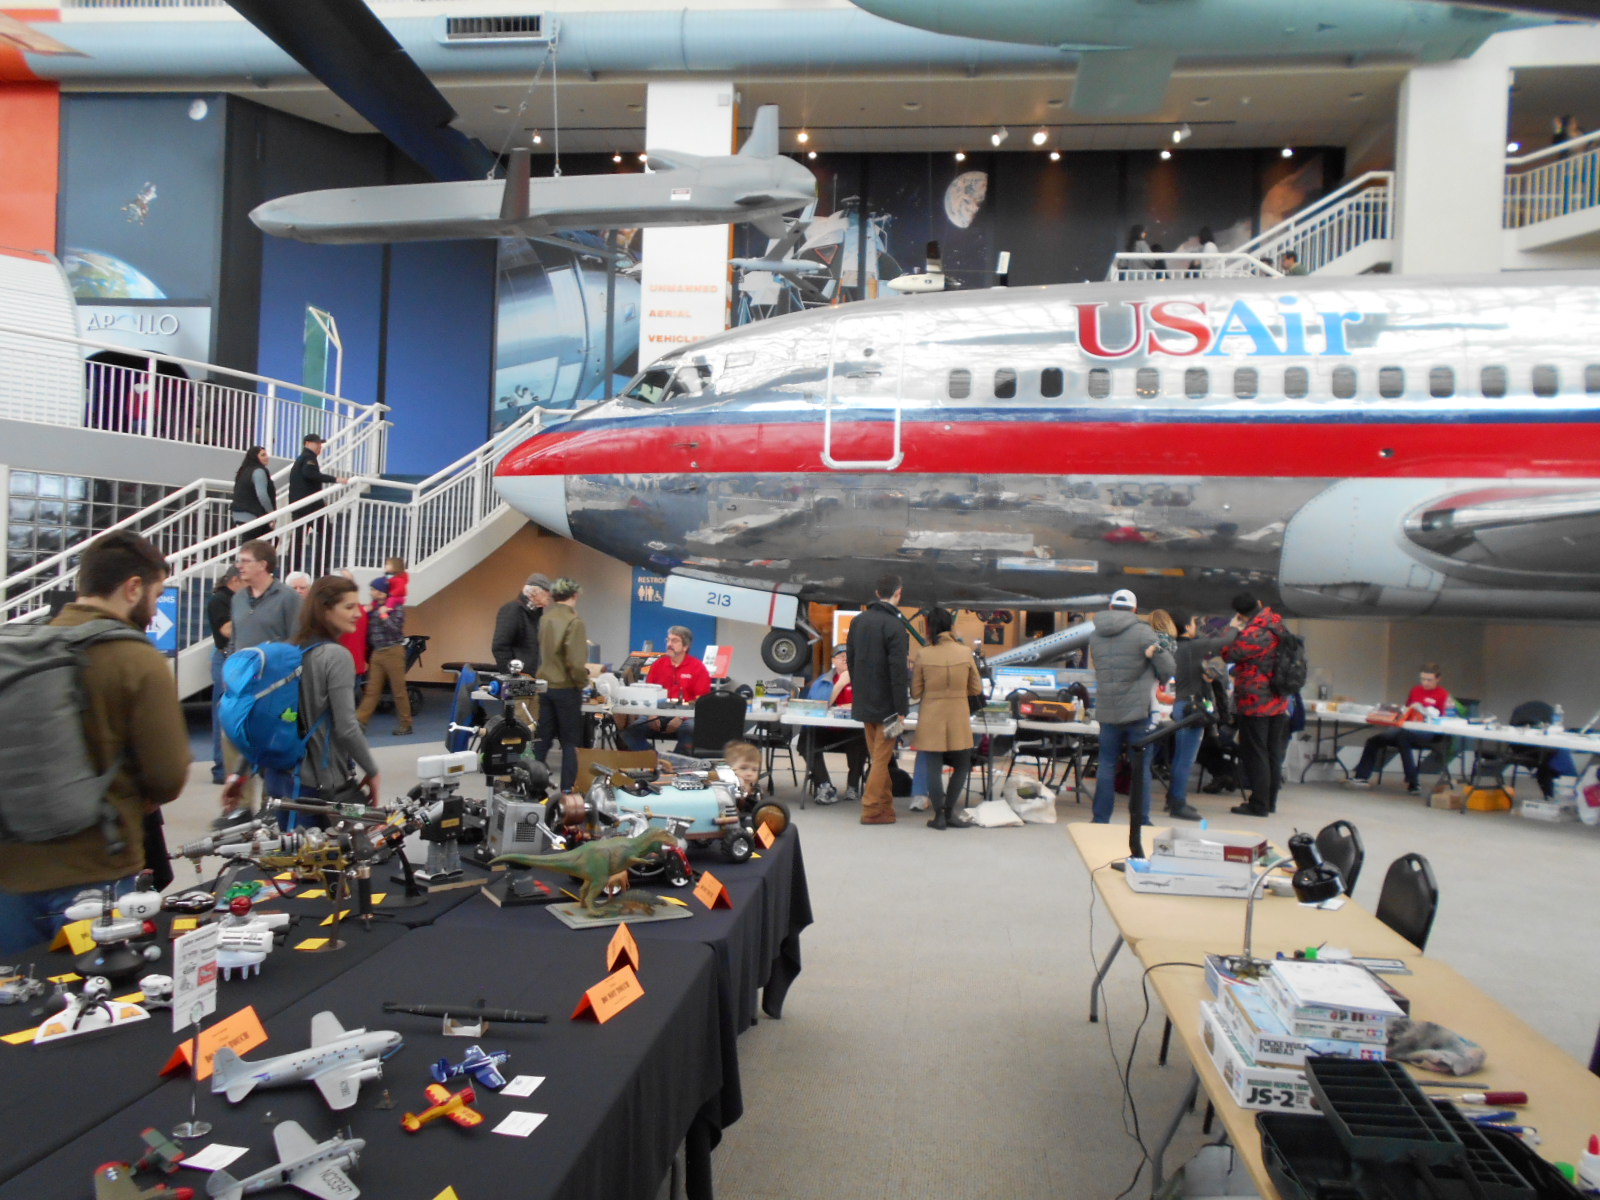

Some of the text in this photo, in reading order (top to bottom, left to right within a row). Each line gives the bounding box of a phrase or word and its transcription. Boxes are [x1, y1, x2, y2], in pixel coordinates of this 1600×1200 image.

[649, 285, 718, 293] UNMANNED
[649, 309, 692, 318] AERIAL
[87, 313, 180, 336] APOLLO
[1072, 295, 1365, 357] USAir
[706, 591, 732, 607] 213
[451, 1065, 465, 1076] 74
[1246, 1087, 1295, 1107] JS-2
